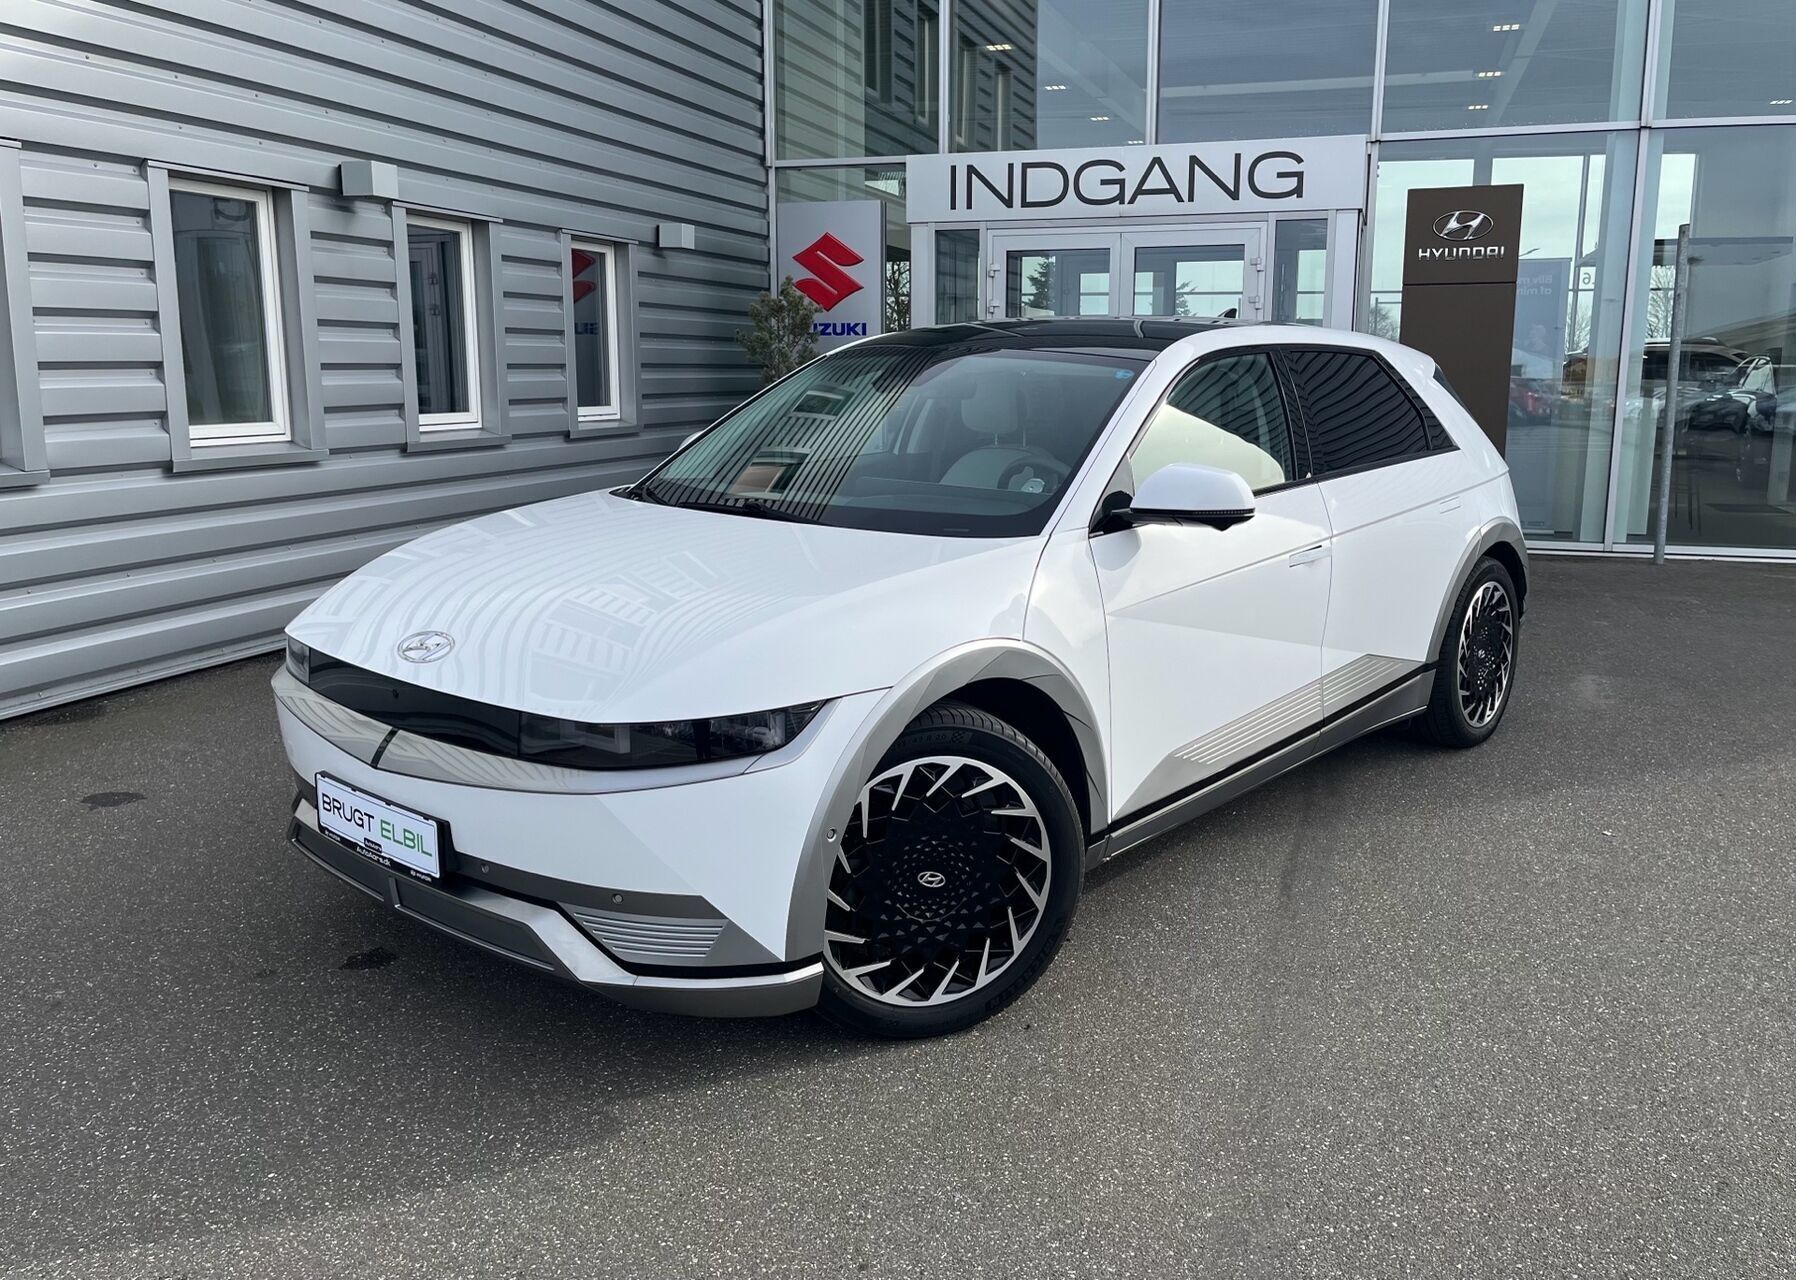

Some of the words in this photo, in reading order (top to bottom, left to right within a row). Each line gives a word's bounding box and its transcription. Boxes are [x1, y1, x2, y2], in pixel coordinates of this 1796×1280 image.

[949, 150, 1305, 211] INDGANG
[1418, 245, 1505, 261] HYUNDAI
[812, 322, 867, 336] ZUKI
[321, 793, 375, 833] BRUGT
[380, 819, 433, 858] ELBIL
